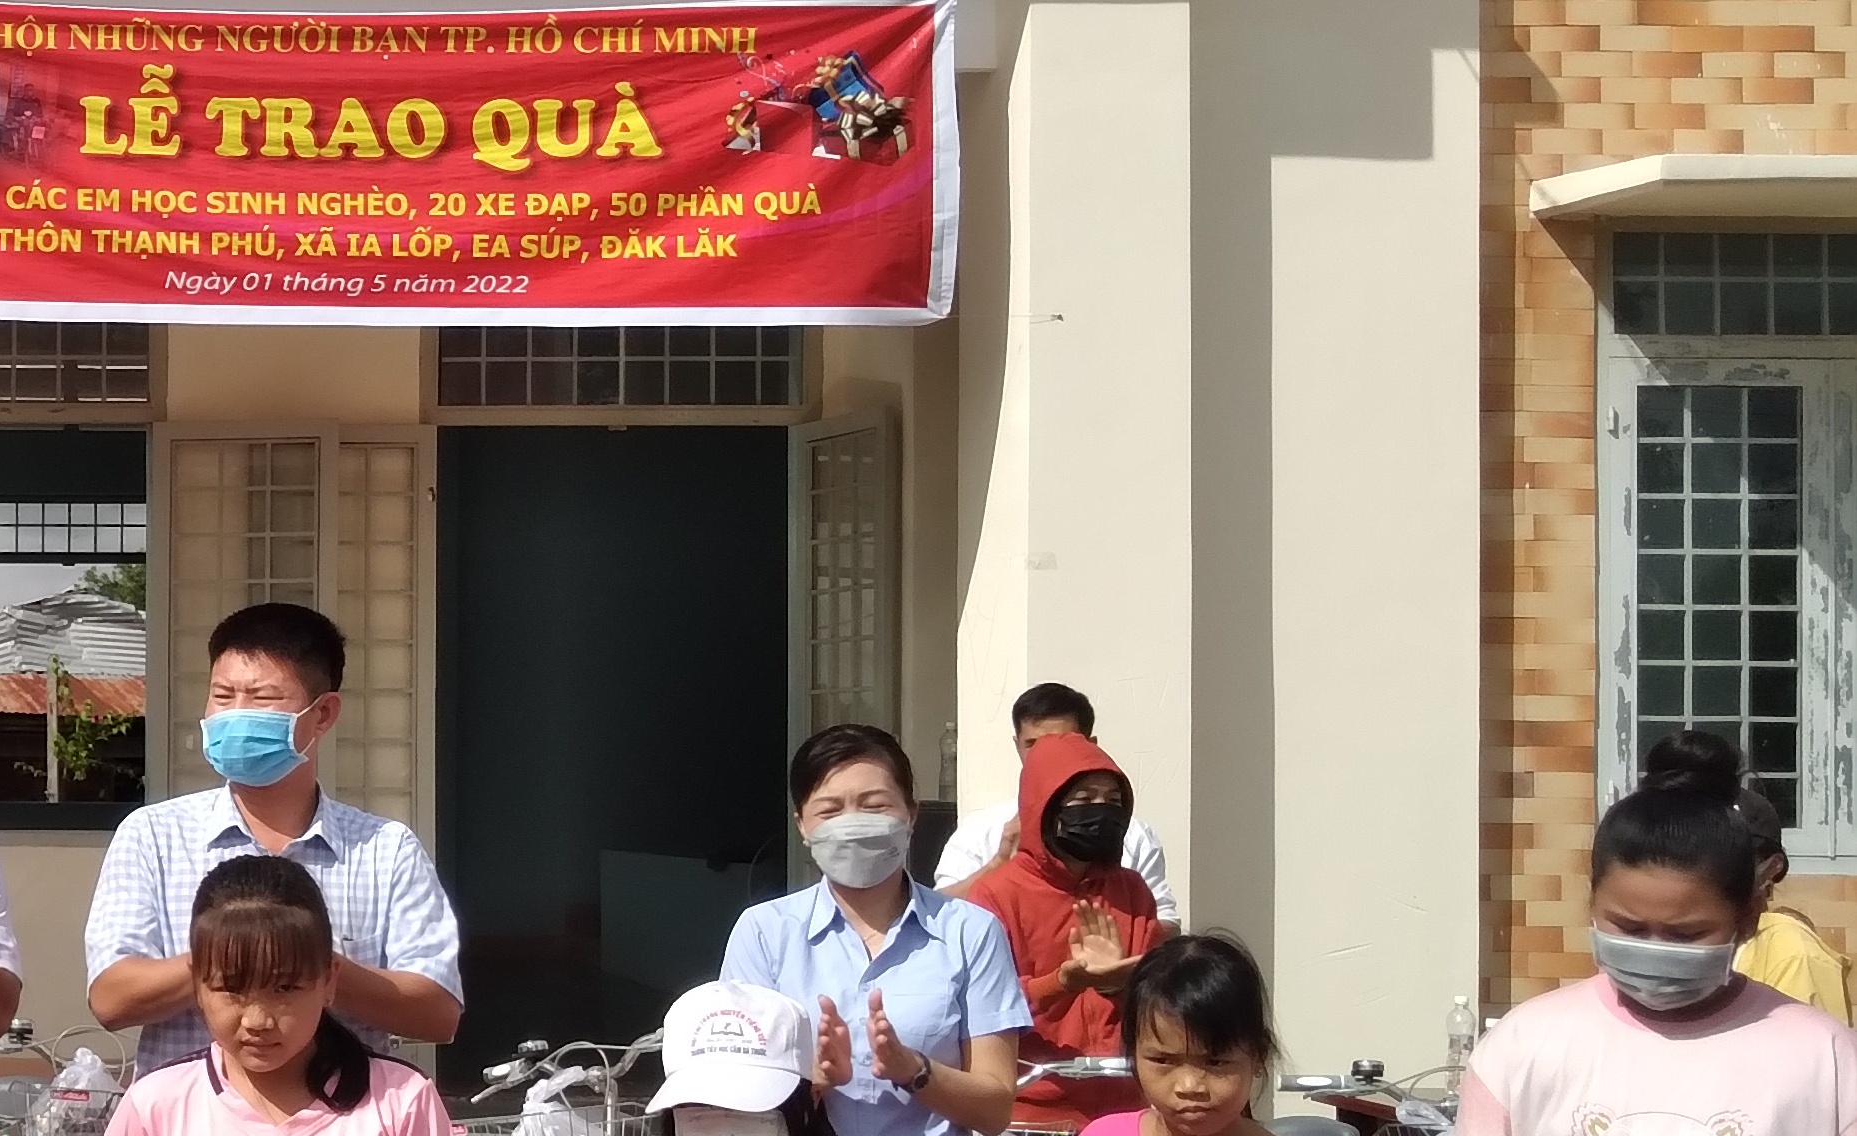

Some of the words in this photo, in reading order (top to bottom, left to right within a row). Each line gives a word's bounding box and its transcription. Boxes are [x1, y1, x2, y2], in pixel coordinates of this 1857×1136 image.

[69, 17, 205, 51] NHỮNG
[216, 18, 340, 53] NGƯỜI
[352, 27, 430, 60] BẠN
[441, 27, 495, 54] TP.
[506, 14, 563, 54] HỒ
[573, 18, 642, 54] CHÍ
[653, 27, 758, 54] MINH
[79, 64, 181, 157] LỄ
[205, 97, 446, 158] TRAO
[472, 82, 663, 171] QUÀ
[5, 179, 66, 210] CÁC
[76, 189, 120, 212] EM
[131, 189, 197, 218] HỌC
[206, 191, 286, 215] SINH
[297, 186, 417, 219] NGHÈO,
[428, 193, 467, 216] 20
[476, 193, 516, 216] XE
[525, 193, 598, 222] ĐẠP,
[610, 193, 648, 217] 50
[657, 185, 744, 217] PHẦN
[753, 184, 822, 220] QUÀ
[92, 230, 200, 260] THẠNH
[211, 225, 284, 260] PHÚ,
[295, 227, 338, 257] XÃ
[347, 234, 382, 257] IA
[392, 226, 461, 261] LỐP,
[472, 234, 511, 258] EA
[519, 228, 589, 263] SÚP,
[599, 228, 667, 259] ĐĂK
[676, 227, 738, 258] LĂK
[164, 271, 238, 295] Ngày
[242, 272, 273, 291] 01
[283, 271, 365, 297] tháng
[370, 274, 387, 292] 5
[393, 273, 456, 293] năm
[461, 275, 530, 294] 2022
